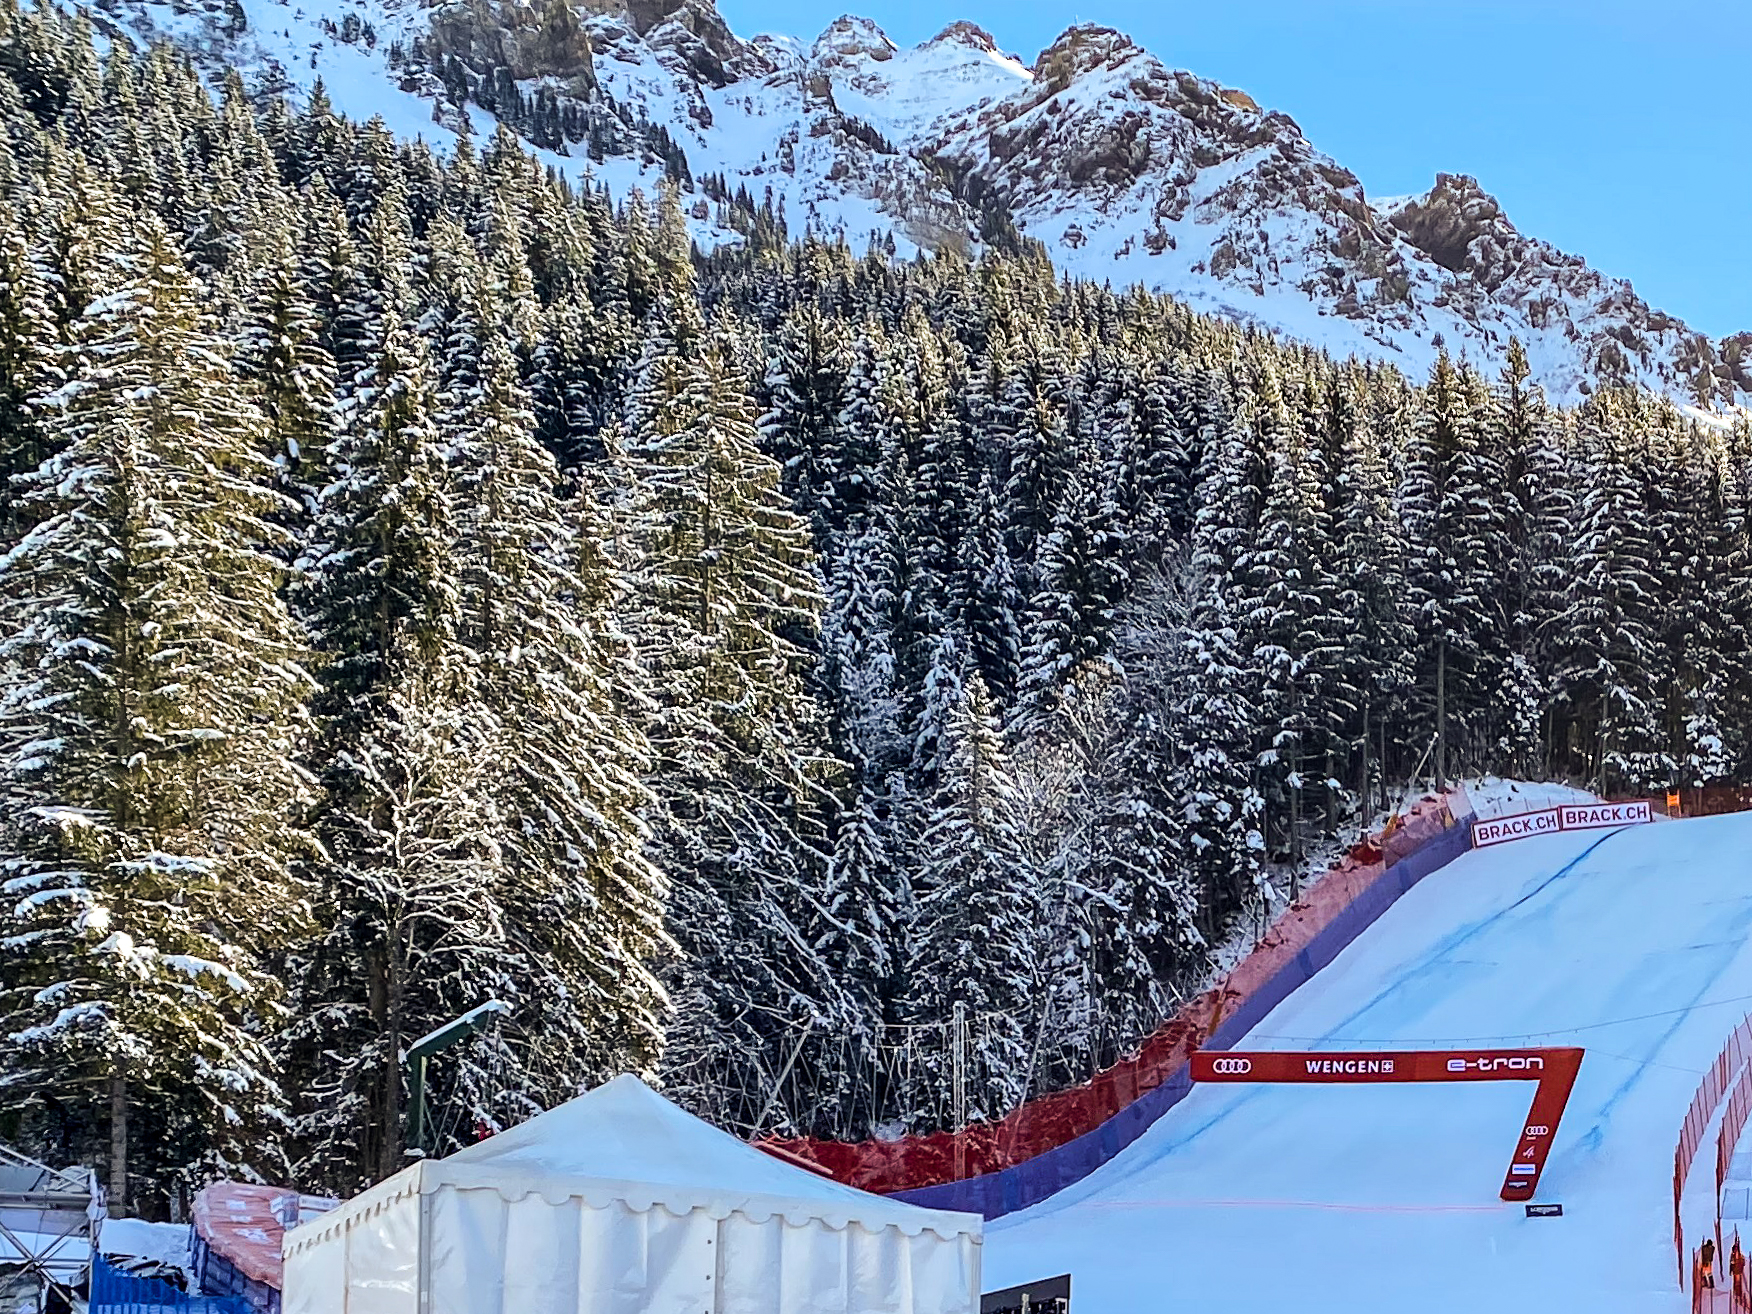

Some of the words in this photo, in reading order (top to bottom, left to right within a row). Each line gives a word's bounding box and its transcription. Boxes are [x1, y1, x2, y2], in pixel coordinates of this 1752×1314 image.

[1565, 806, 1647, 825] BRACK.CH
[1478, 815, 1557, 840] BRACK.CH
[1306, 1060, 1381, 1074] WENGEN
[1447, 1056, 1544, 1072] e-tron
